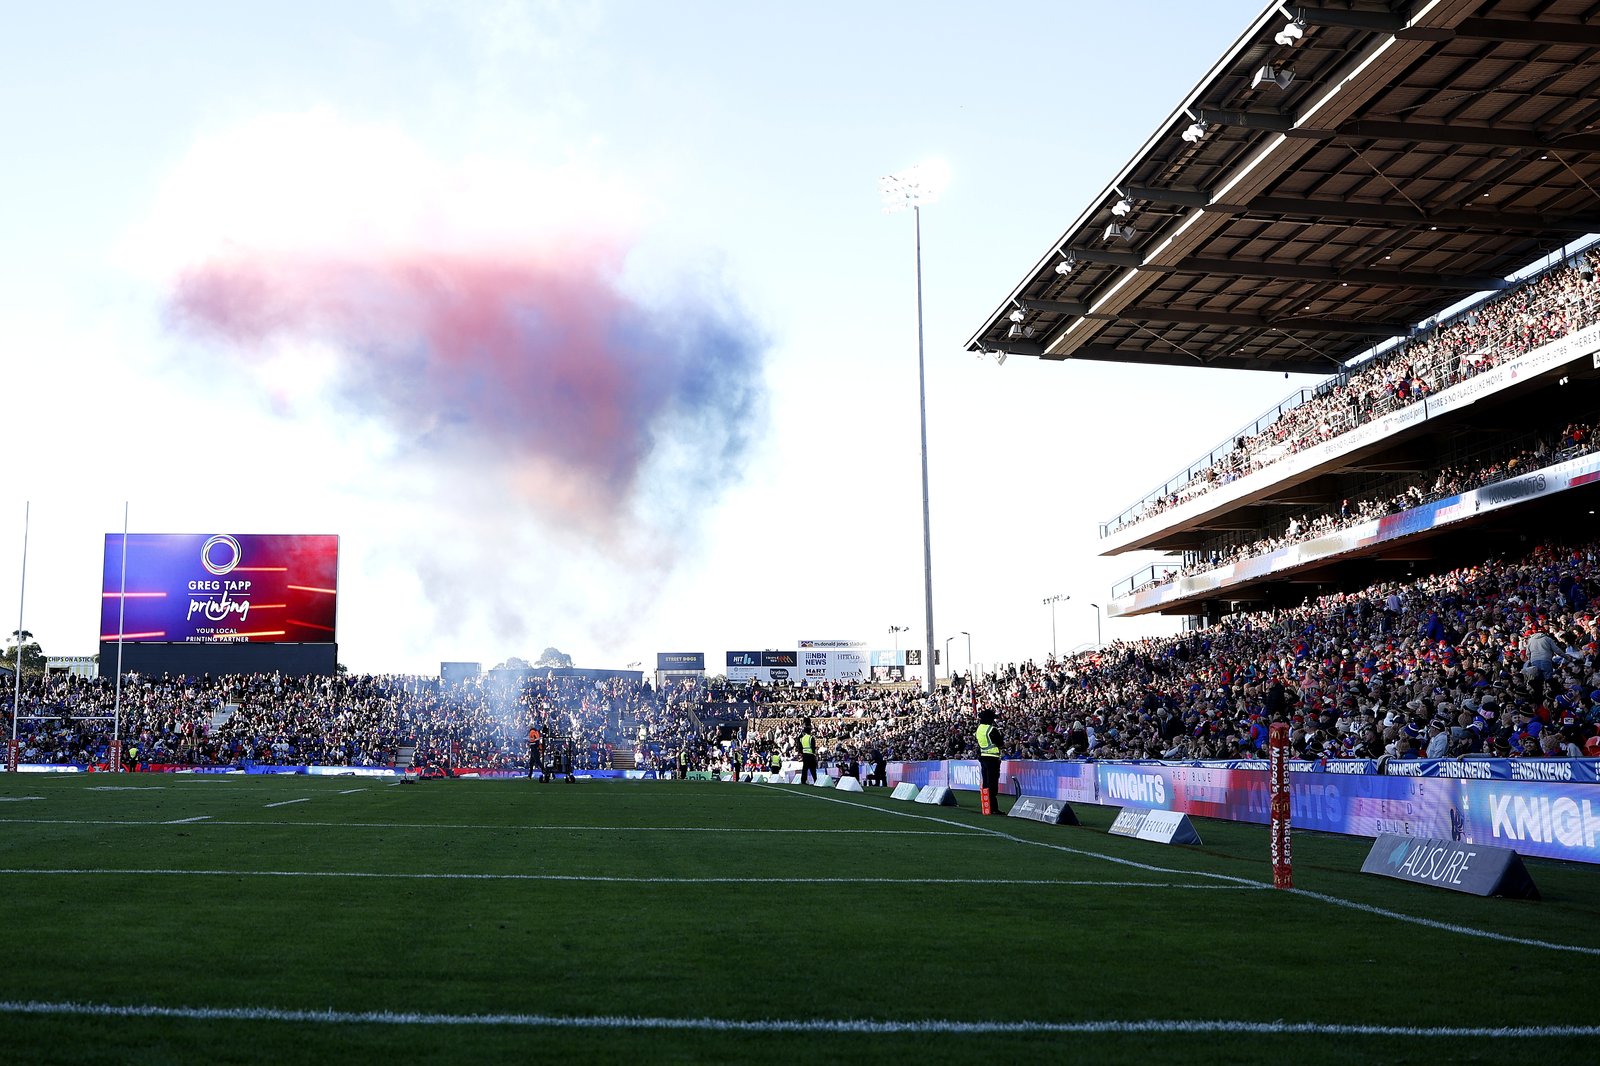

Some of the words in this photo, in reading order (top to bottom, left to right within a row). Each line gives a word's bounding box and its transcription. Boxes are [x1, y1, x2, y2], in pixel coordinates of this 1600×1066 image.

[1488, 473, 1547, 505] KNIGHTS
[188, 580, 221, 591] GREG
[223, 580, 252, 591] TAPP
[186, 590, 251, 622] printing
[953, 765, 981, 786] KNIGHTS
[1271, 746, 1280, 794] Macca's
[1401, 763, 1422, 777] NEWS
[1465, 762, 1492, 779] NEWS
[1519, 762, 1542, 780] NBN
[1542, 762, 1572, 780] NEWS
[1107, 772, 1166, 804] KNIGHTS
[1283, 818, 1292, 866] Macca's
[1397, 845, 1477, 885] AUSURE
